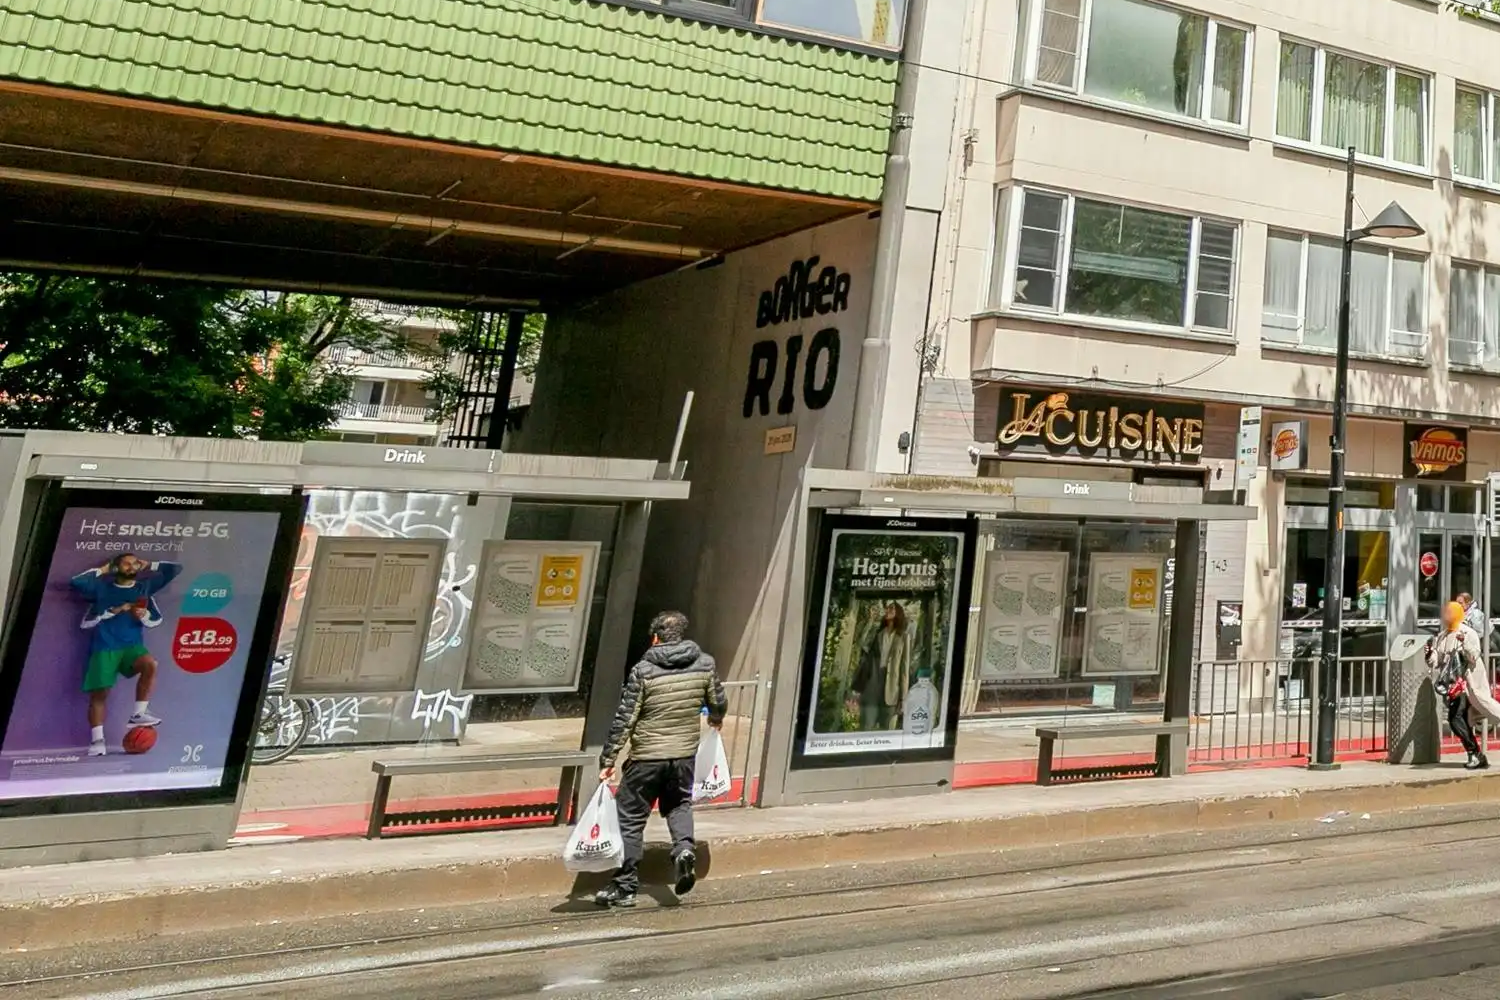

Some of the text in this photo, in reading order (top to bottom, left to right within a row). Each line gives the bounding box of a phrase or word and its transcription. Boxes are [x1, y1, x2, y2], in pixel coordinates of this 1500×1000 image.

[743, 328, 841, 418] RIO
[1045, 406, 1203, 455] CUISINE
[384, 448, 427, 464] Drink
[1410, 440, 1466, 463] VAMOS
[1064, 483, 1090, 496] Drink
[154, 495, 204, 505] JCDecaux
[80, 519, 117, 536] Het
[118, 520, 194, 538] snelste
[75, 540, 184, 552] wat een verschil
[852, 558, 938, 576] Herbruis
[851, 577, 936, 589] met fijne bubbels
[192, 588, 227, 598] 70 GB
[179, 629, 233, 646] €18.99
[911, 712, 929, 721] SPA
[575, 839, 612, 852] Karim
